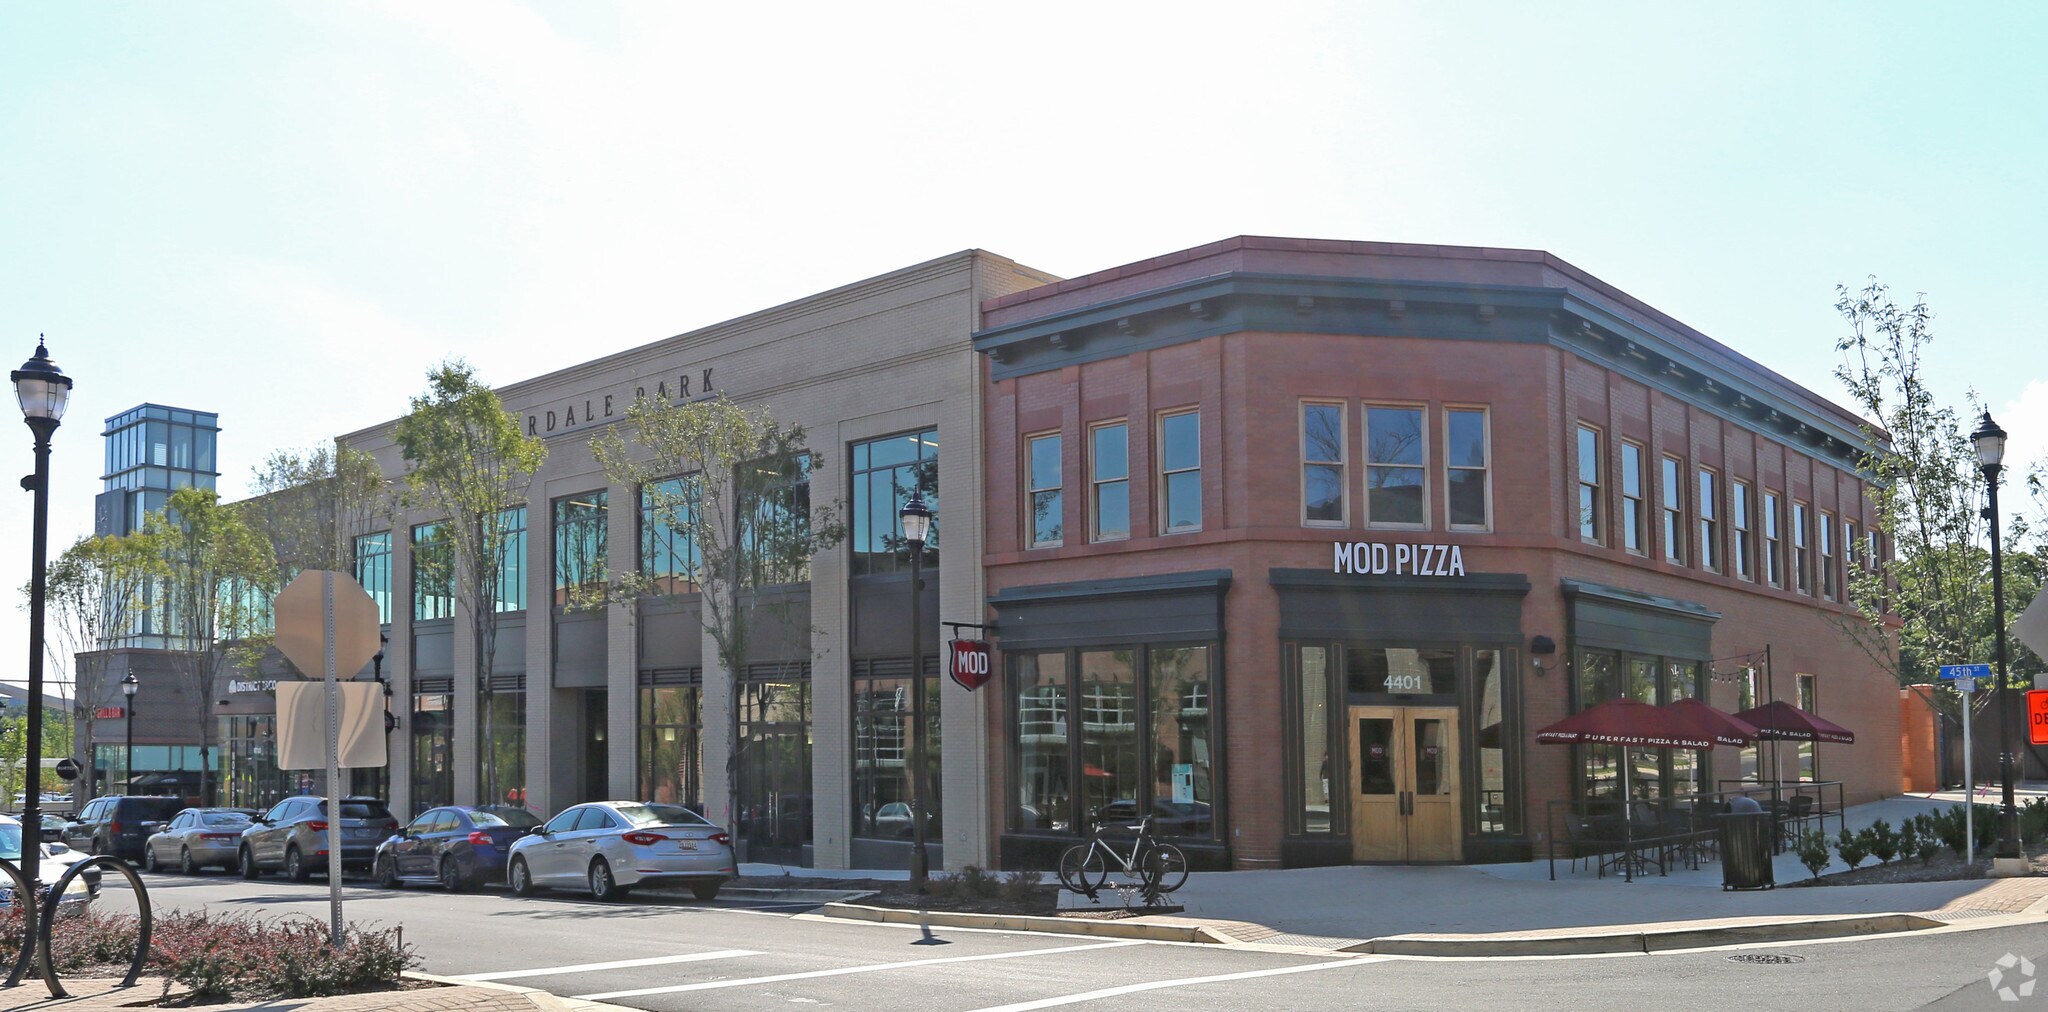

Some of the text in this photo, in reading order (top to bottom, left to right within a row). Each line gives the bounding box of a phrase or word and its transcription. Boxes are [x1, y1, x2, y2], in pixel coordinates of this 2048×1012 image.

[528, 394, 613, 436] RDALE
[1334, 541, 1465, 577] MOD PIZZA
[958, 651, 988, 675] MOD
[1949, 667, 1972, 677] 45th
[236, 680, 260, 692] DISTRICT
[1383, 674, 1422, 690] 4401
[1584, 733, 1644, 744] SUPERFAST
[1647, 737, 1671, 745] PIZZA
[1681, 739, 1709, 747] SALAD
[1717, 736, 1743, 745] SALAD
